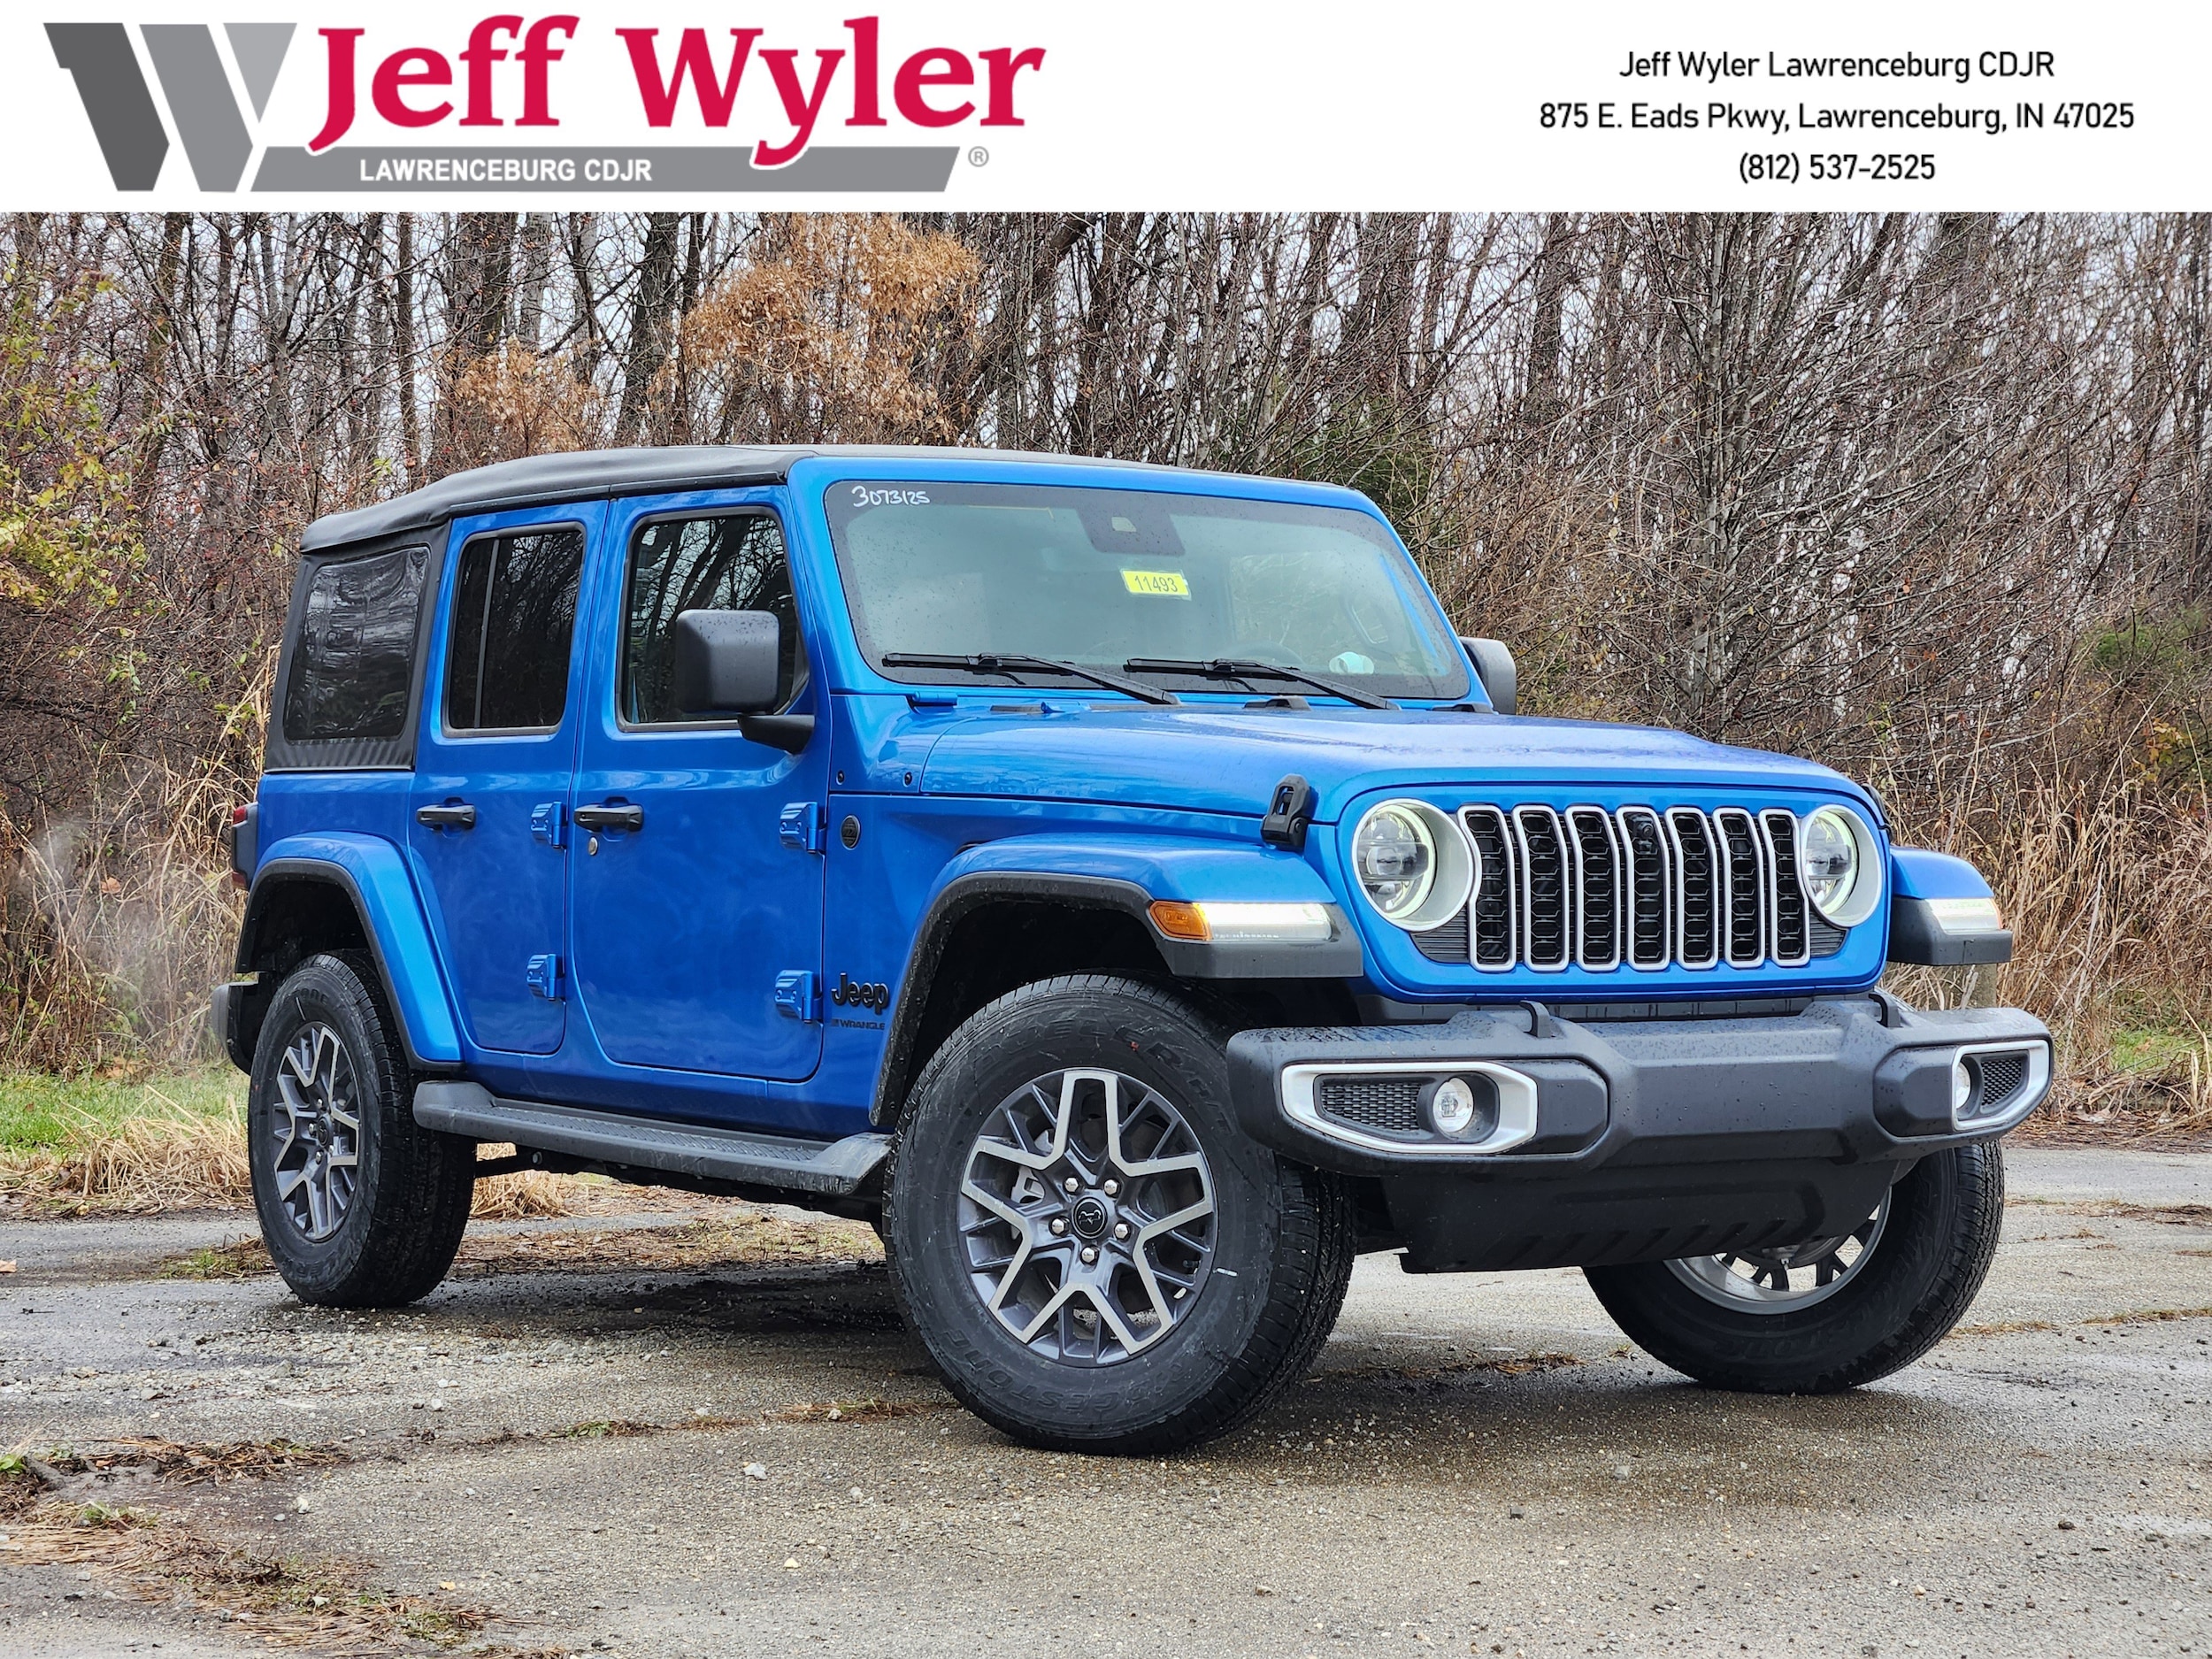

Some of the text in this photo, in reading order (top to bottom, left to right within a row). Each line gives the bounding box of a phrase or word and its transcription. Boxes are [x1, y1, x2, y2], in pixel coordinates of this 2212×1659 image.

[851, 485, 931, 508] 3073125
[1134, 575, 1179, 593] 11493
[831, 972, 889, 1016] Jeep
[840, 1018, 886, 1031] WRANGLE
